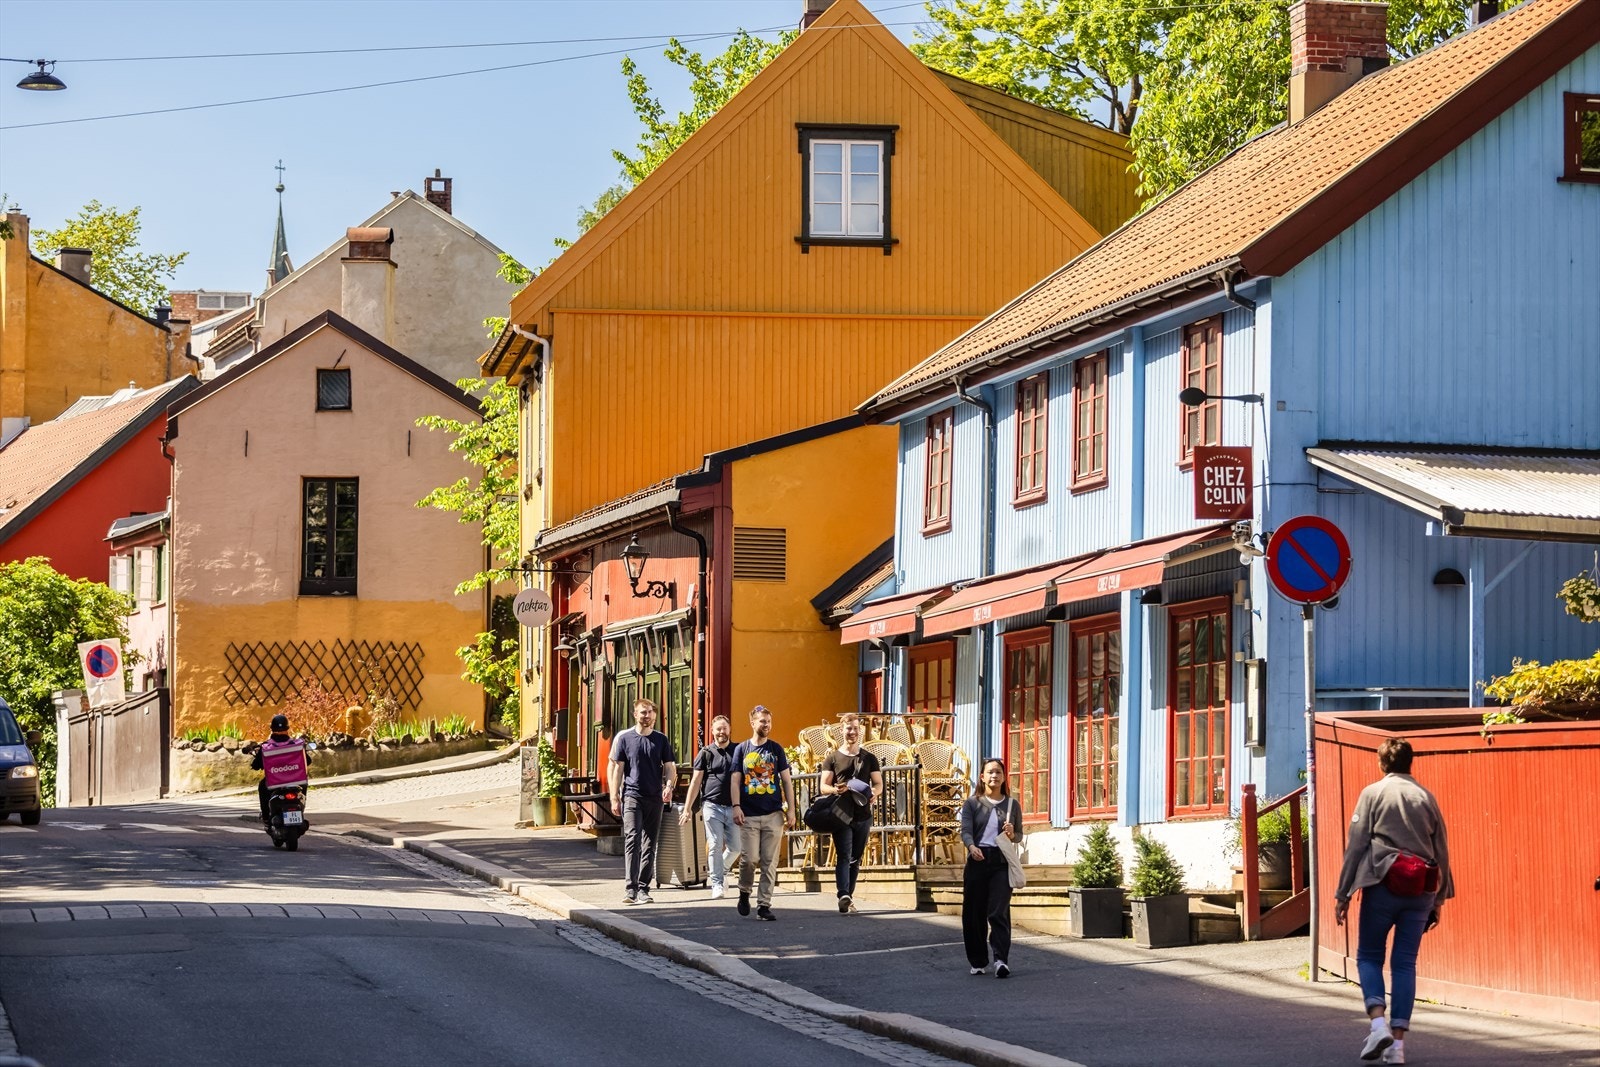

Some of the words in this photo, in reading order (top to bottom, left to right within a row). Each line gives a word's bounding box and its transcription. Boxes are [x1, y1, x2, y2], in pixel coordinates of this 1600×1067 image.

[1206, 455, 1242, 464] RESTAURANT
[1203, 466, 1245, 486] CHEZ
[1204, 487, 1246, 505] COLIN
[270, 764, 299, 774] foodora
